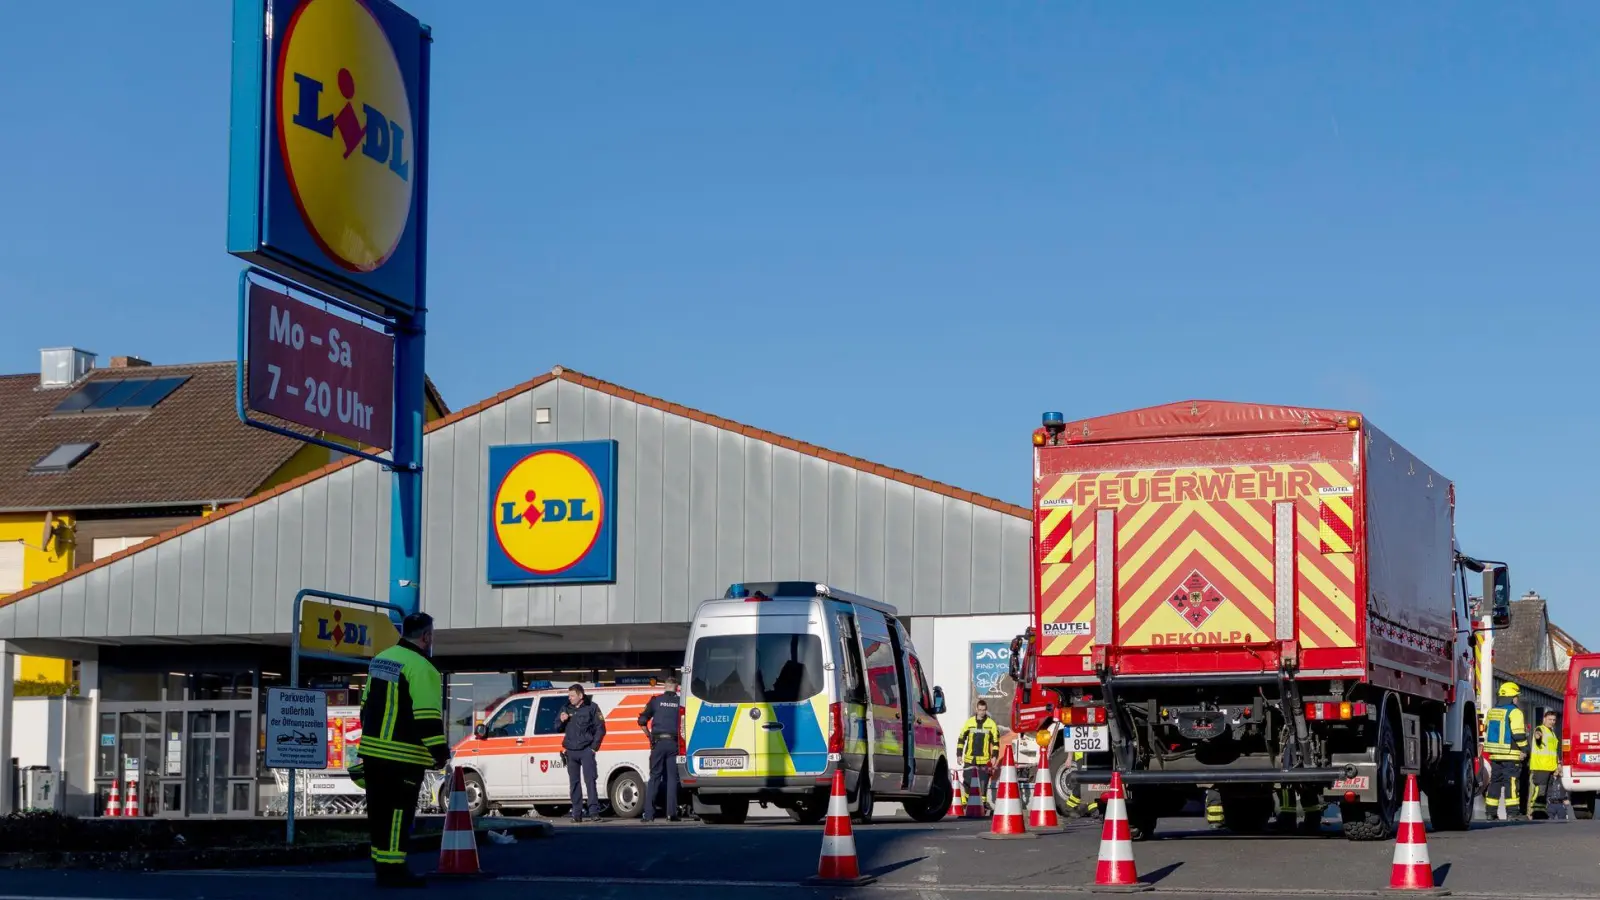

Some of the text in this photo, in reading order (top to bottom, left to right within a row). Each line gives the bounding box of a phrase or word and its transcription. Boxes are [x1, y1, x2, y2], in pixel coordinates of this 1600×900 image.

[269, 305, 304, 350] Mo
[328, 328, 352, 367] Sa
[268, 364, 281, 400] 7
[304, 377, 331, 417] 20
[337, 387, 373, 430] Uhr
[1076, 469, 1313, 507] FEUERWEHR
[1043, 622, 1089, 631] DAUTEL
[1151, 631, 1242, 645] DEKON-P
[280, 692, 316, 703] Parkverbot
[281, 706, 314, 716] außerhalb
[271, 717, 324, 728] der Öffnungszeiten
[700, 715, 730, 723] POLIZEI
[1075, 727, 1089, 738] SW
[1580, 732, 1600, 743] FE
[1073, 739, 1101, 750] 8502
